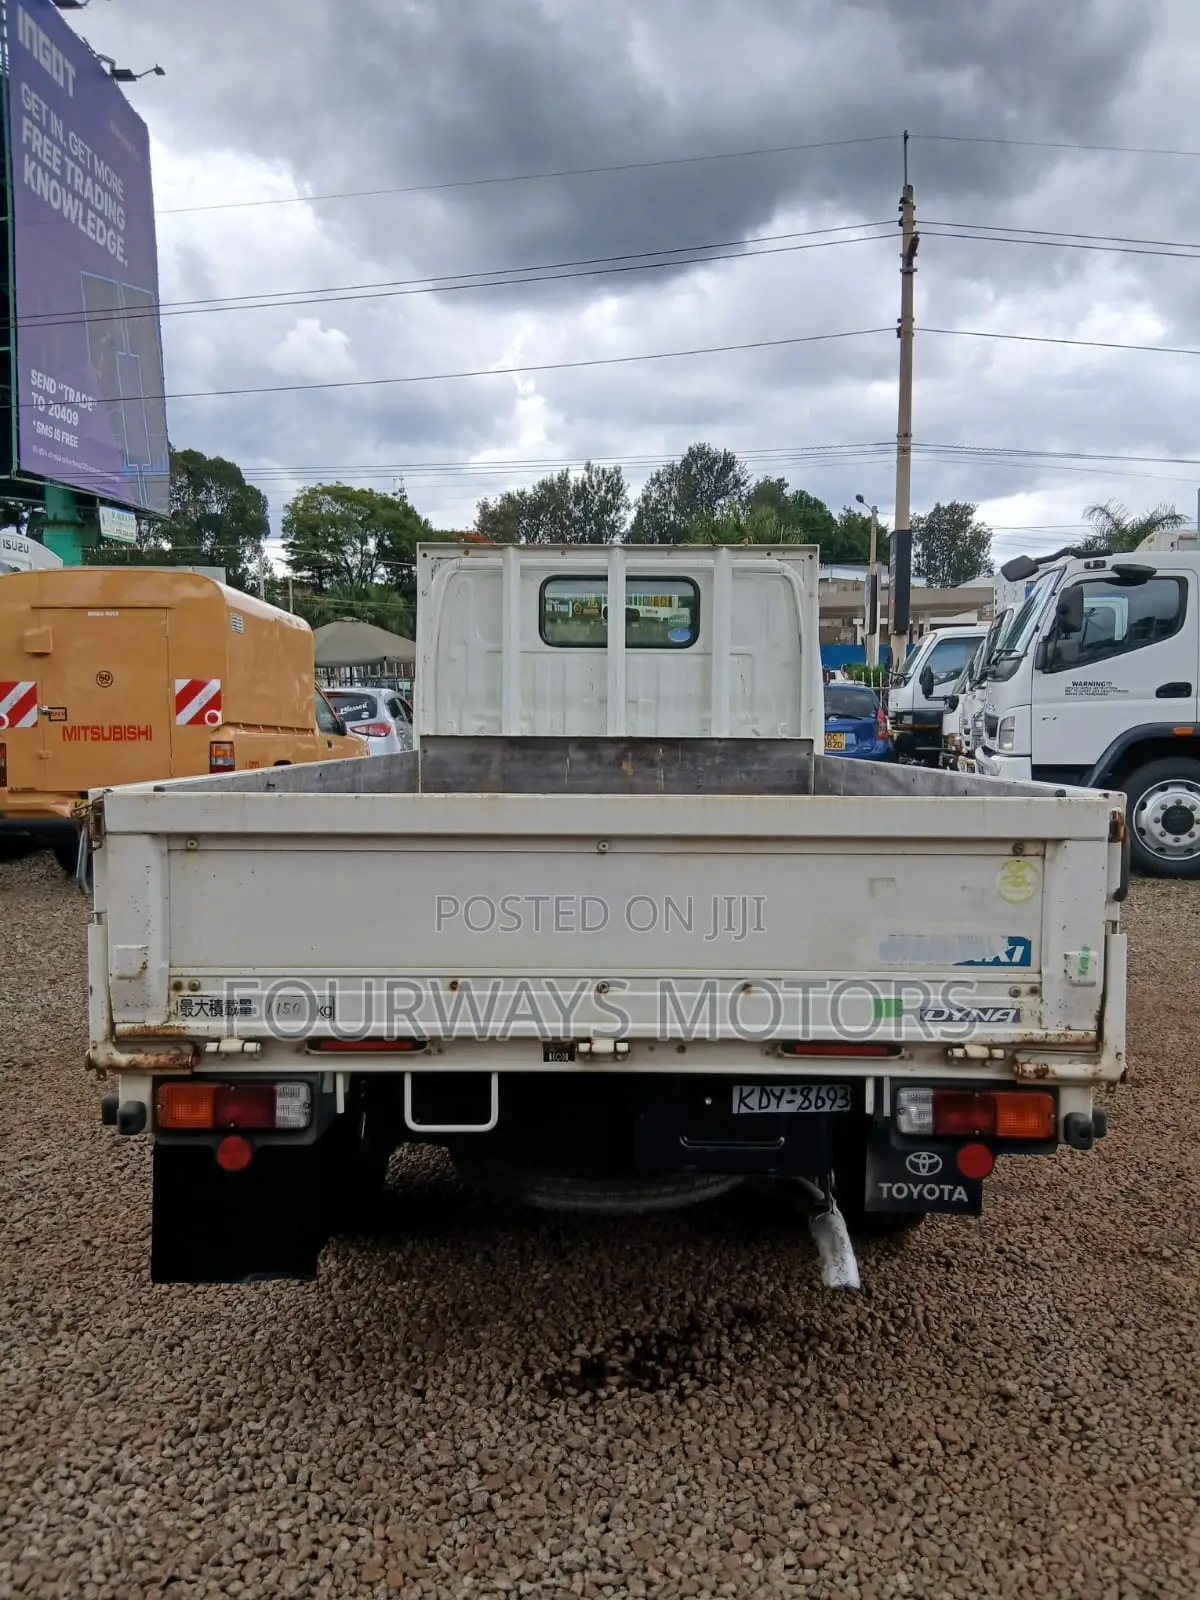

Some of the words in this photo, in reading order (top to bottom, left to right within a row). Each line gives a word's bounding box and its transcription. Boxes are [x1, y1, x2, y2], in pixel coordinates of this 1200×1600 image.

[21, 82, 49, 119] GET
[50, 108, 67, 148] IN.
[69, 130, 93, 166] GET
[94, 158, 124, 201] MORE
[22, 118, 61, 177] FREE
[64, 155, 126, 231] TRADING
[23, 153, 128, 266] KNOWLEDGE.
[30, 368, 57, 395] SEND
[31, 391, 45, 412] TO
[48, 398, 79, 427] 20409
[53, 425, 62, 443] IS
[61, 430, 79, 448] FREE
[2, 538, 29, 554] ISUZU
[62, 724, 153, 742] MITSUBISHI
[179, 998, 253, 1018] 最大積載量
[317, 1003, 333, 1019] kg
[923, 1007, 1017, 1023] DYNA
[737, 1086, 850, 1112] KDY-8693
[878, 1182, 969, 1203] TOYOTA
